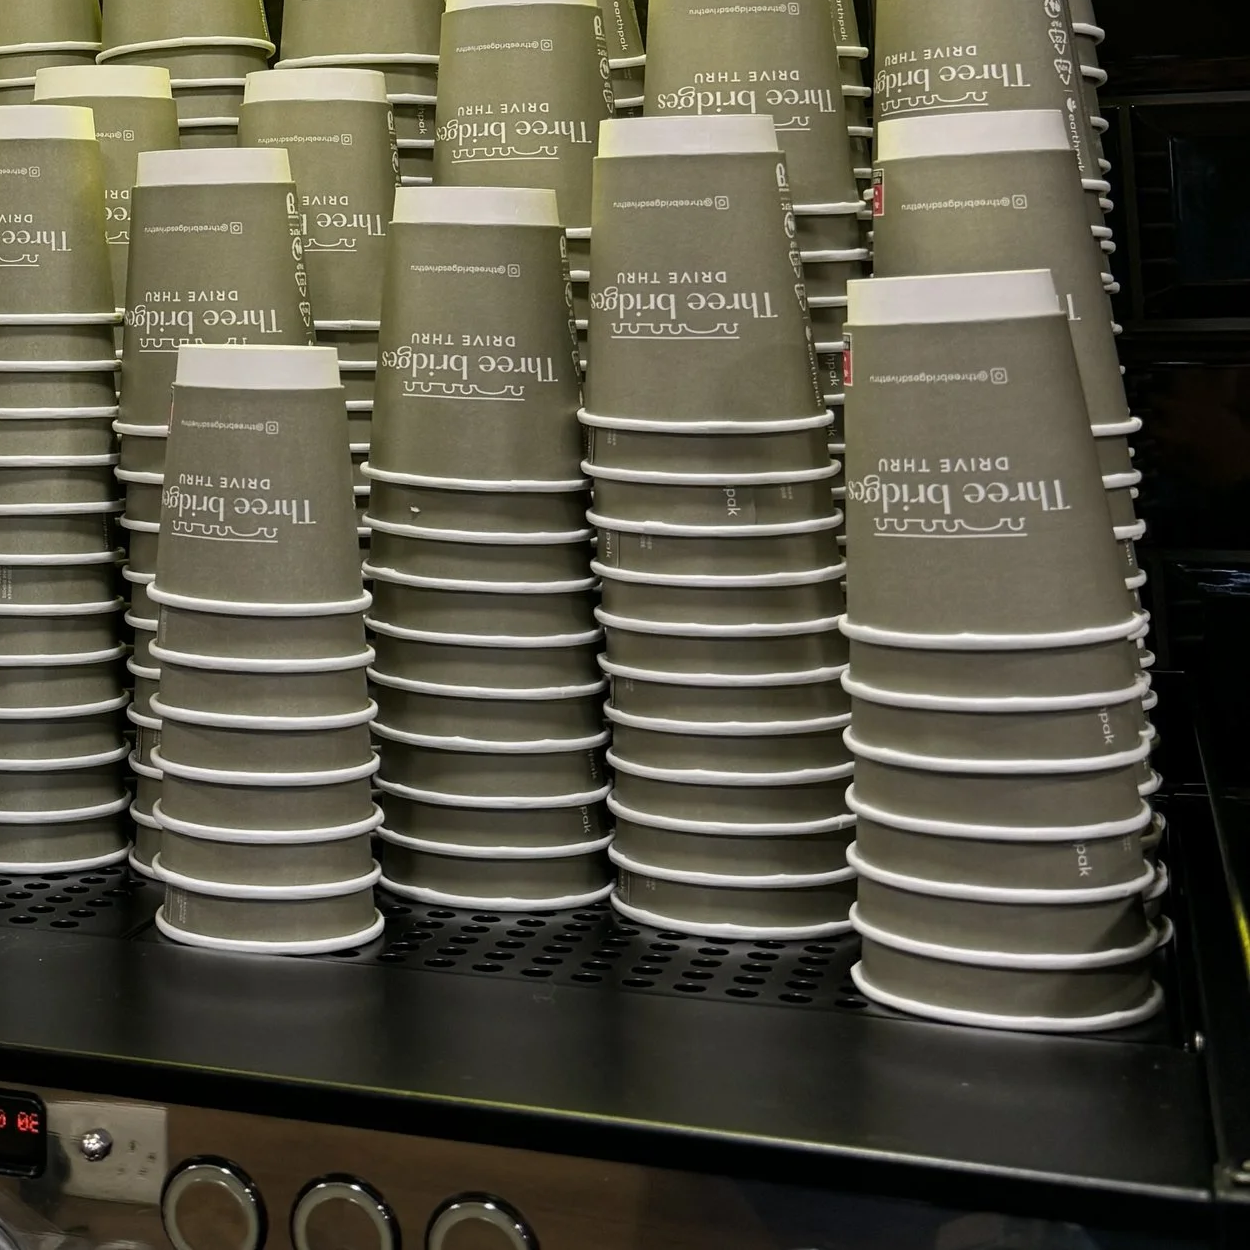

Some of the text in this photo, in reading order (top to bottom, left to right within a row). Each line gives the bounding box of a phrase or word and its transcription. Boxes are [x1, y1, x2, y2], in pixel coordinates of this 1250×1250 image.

[689, 3, 787, 16] @threebridgesdrivethru
[884, 45, 977, 66] DRIVE THRU
[694, 70, 800, 83] DRIVE THRU
[938, 63, 1031, 87] Three
[457, 102, 549, 116] DRIVE THRU
[657, 86, 836, 115] Three bridges
[436, 119, 592, 146] Three bridges
[105, 190, 129, 199] DRI
[302, 195, 348, 205] DRIVE
[316, 213, 386, 236] Three
[1, 230, 72, 252] Three
[617, 271, 727, 284] DRIVE THRU
[145, 290, 238, 302] DRIVE THRU
[590, 286, 778, 320] Three bridges
[202, 309, 282, 333] Three
[410, 333, 516, 347] DRIVE THRU
[382, 346, 558, 382] Three bridges
[870, 370, 988, 383] @threebridgesdrivethru
[878, 457, 1009, 472] DRIVE THRU
[179, 473, 270, 490] DRIVE THRU
[847, 474, 1072, 515] Three bridges
[233, 497, 317, 524] Three
